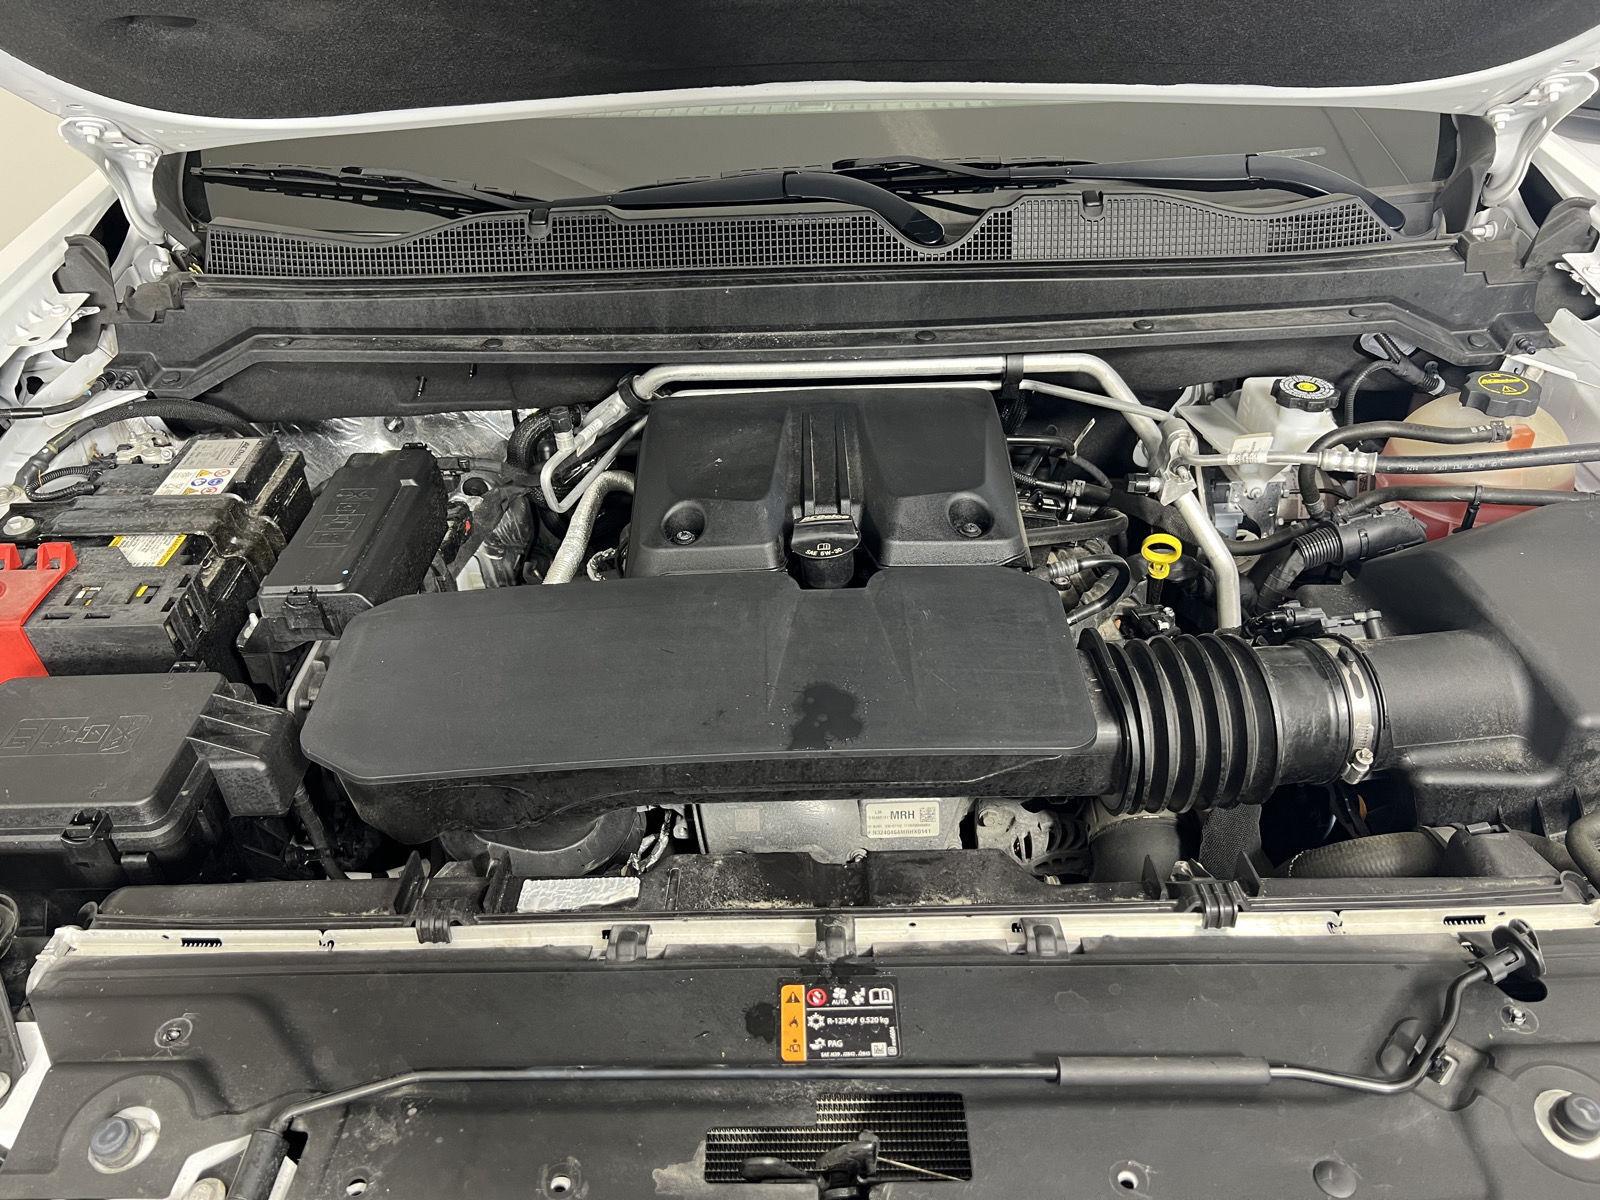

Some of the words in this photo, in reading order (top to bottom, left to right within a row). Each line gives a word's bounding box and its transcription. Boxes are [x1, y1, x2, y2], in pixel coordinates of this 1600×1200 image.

[890, 810, 915, 819] MRH
[826, 1016, 858, 1026] R-1234yf
[859, 1016, 879, 1025] 0.520
[879, 1015, 889, 1025] kg
[827, 1040, 843, 1048] PAG
